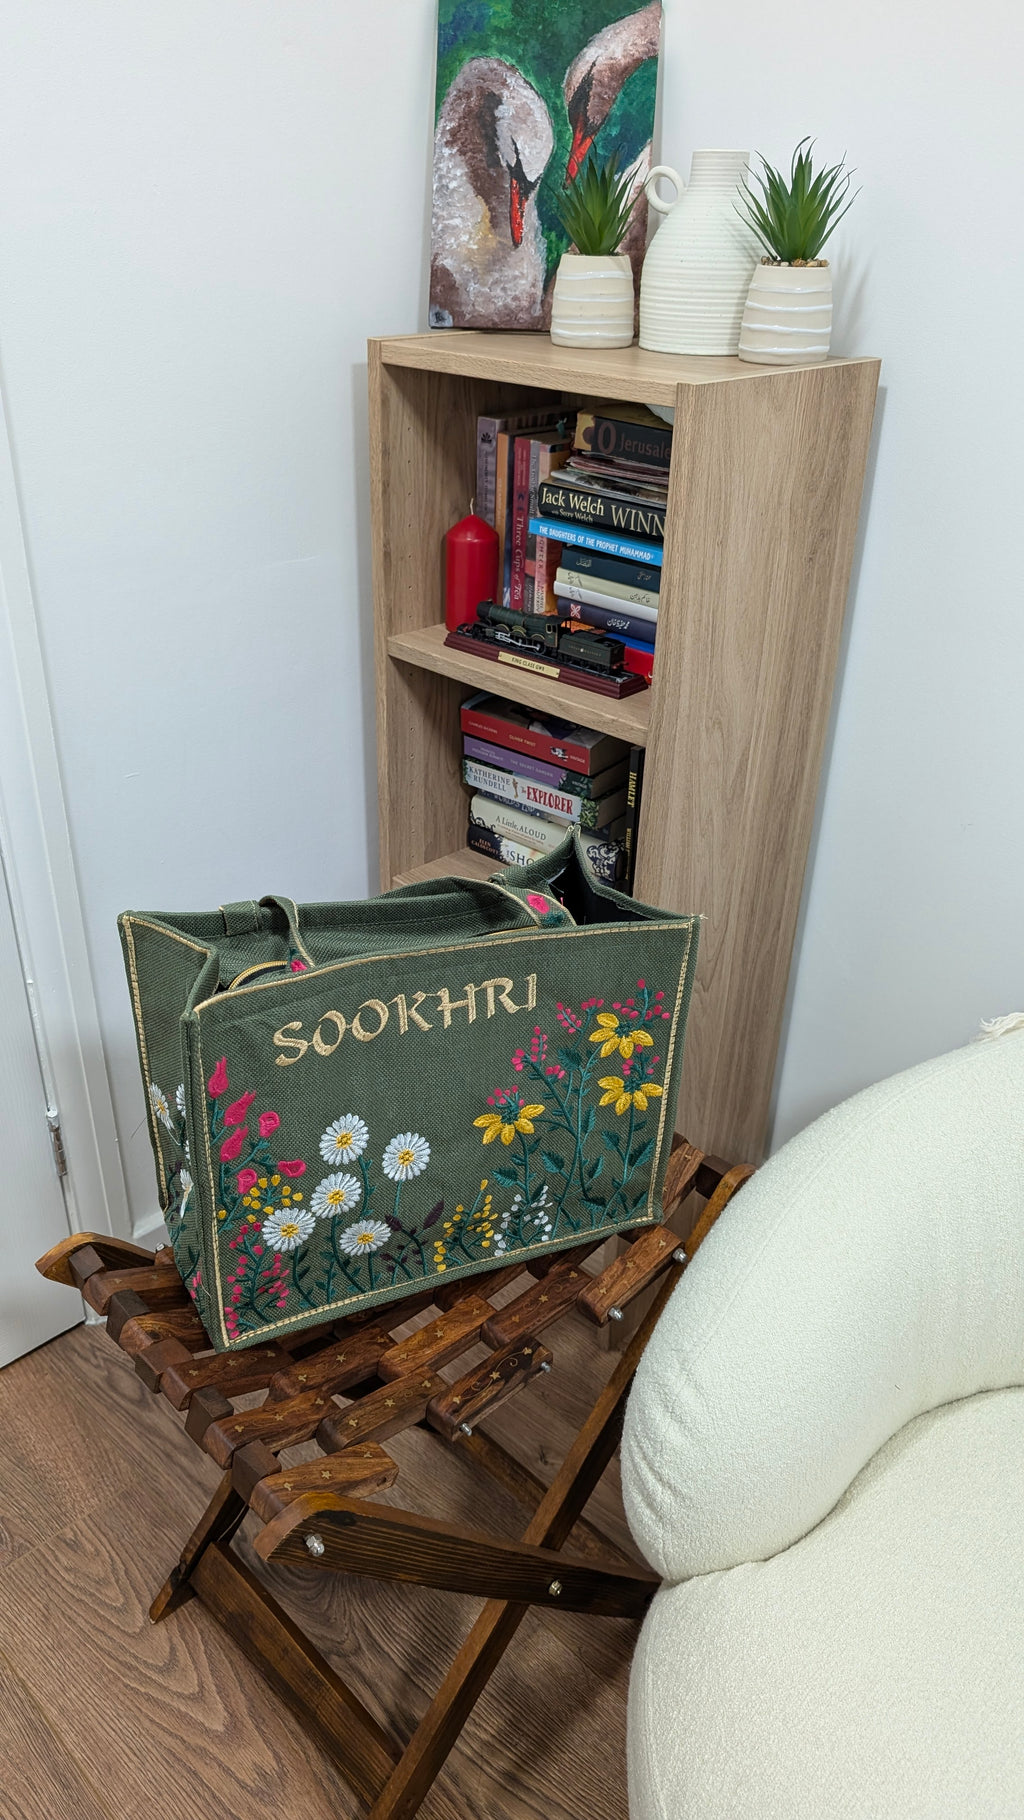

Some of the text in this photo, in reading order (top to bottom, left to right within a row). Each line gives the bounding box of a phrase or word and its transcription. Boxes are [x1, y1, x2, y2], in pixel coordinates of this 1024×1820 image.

[620, 432, 672, 460] Jerusale
[541, 487, 604, 516] Jack Welch
[611, 504, 666, 537] WINN
[539, 525, 548, 535] THE
[549, 528, 577, 541] DAUGHTERS
[577, 535, 585, 543] OF
[586, 537, 595, 547] THE
[595, 539, 619, 552] PROPHET
[619, 545, 651, 560] MUHAMMAD
[513, 516, 524, 600] Three Cups of Tea
[522, 660, 535, 669] CLASS
[469, 766, 511, 785] KATHERINE
[473, 775, 507, 792] RUNDELL
[627, 771, 637, 808] HAMLET
[526, 786, 573, 815] EXPLORER
[519, 828, 547, 841] ALOUD
[509, 850, 535, 866] SHO
[273, 973, 537, 1067] SOOKHRI
